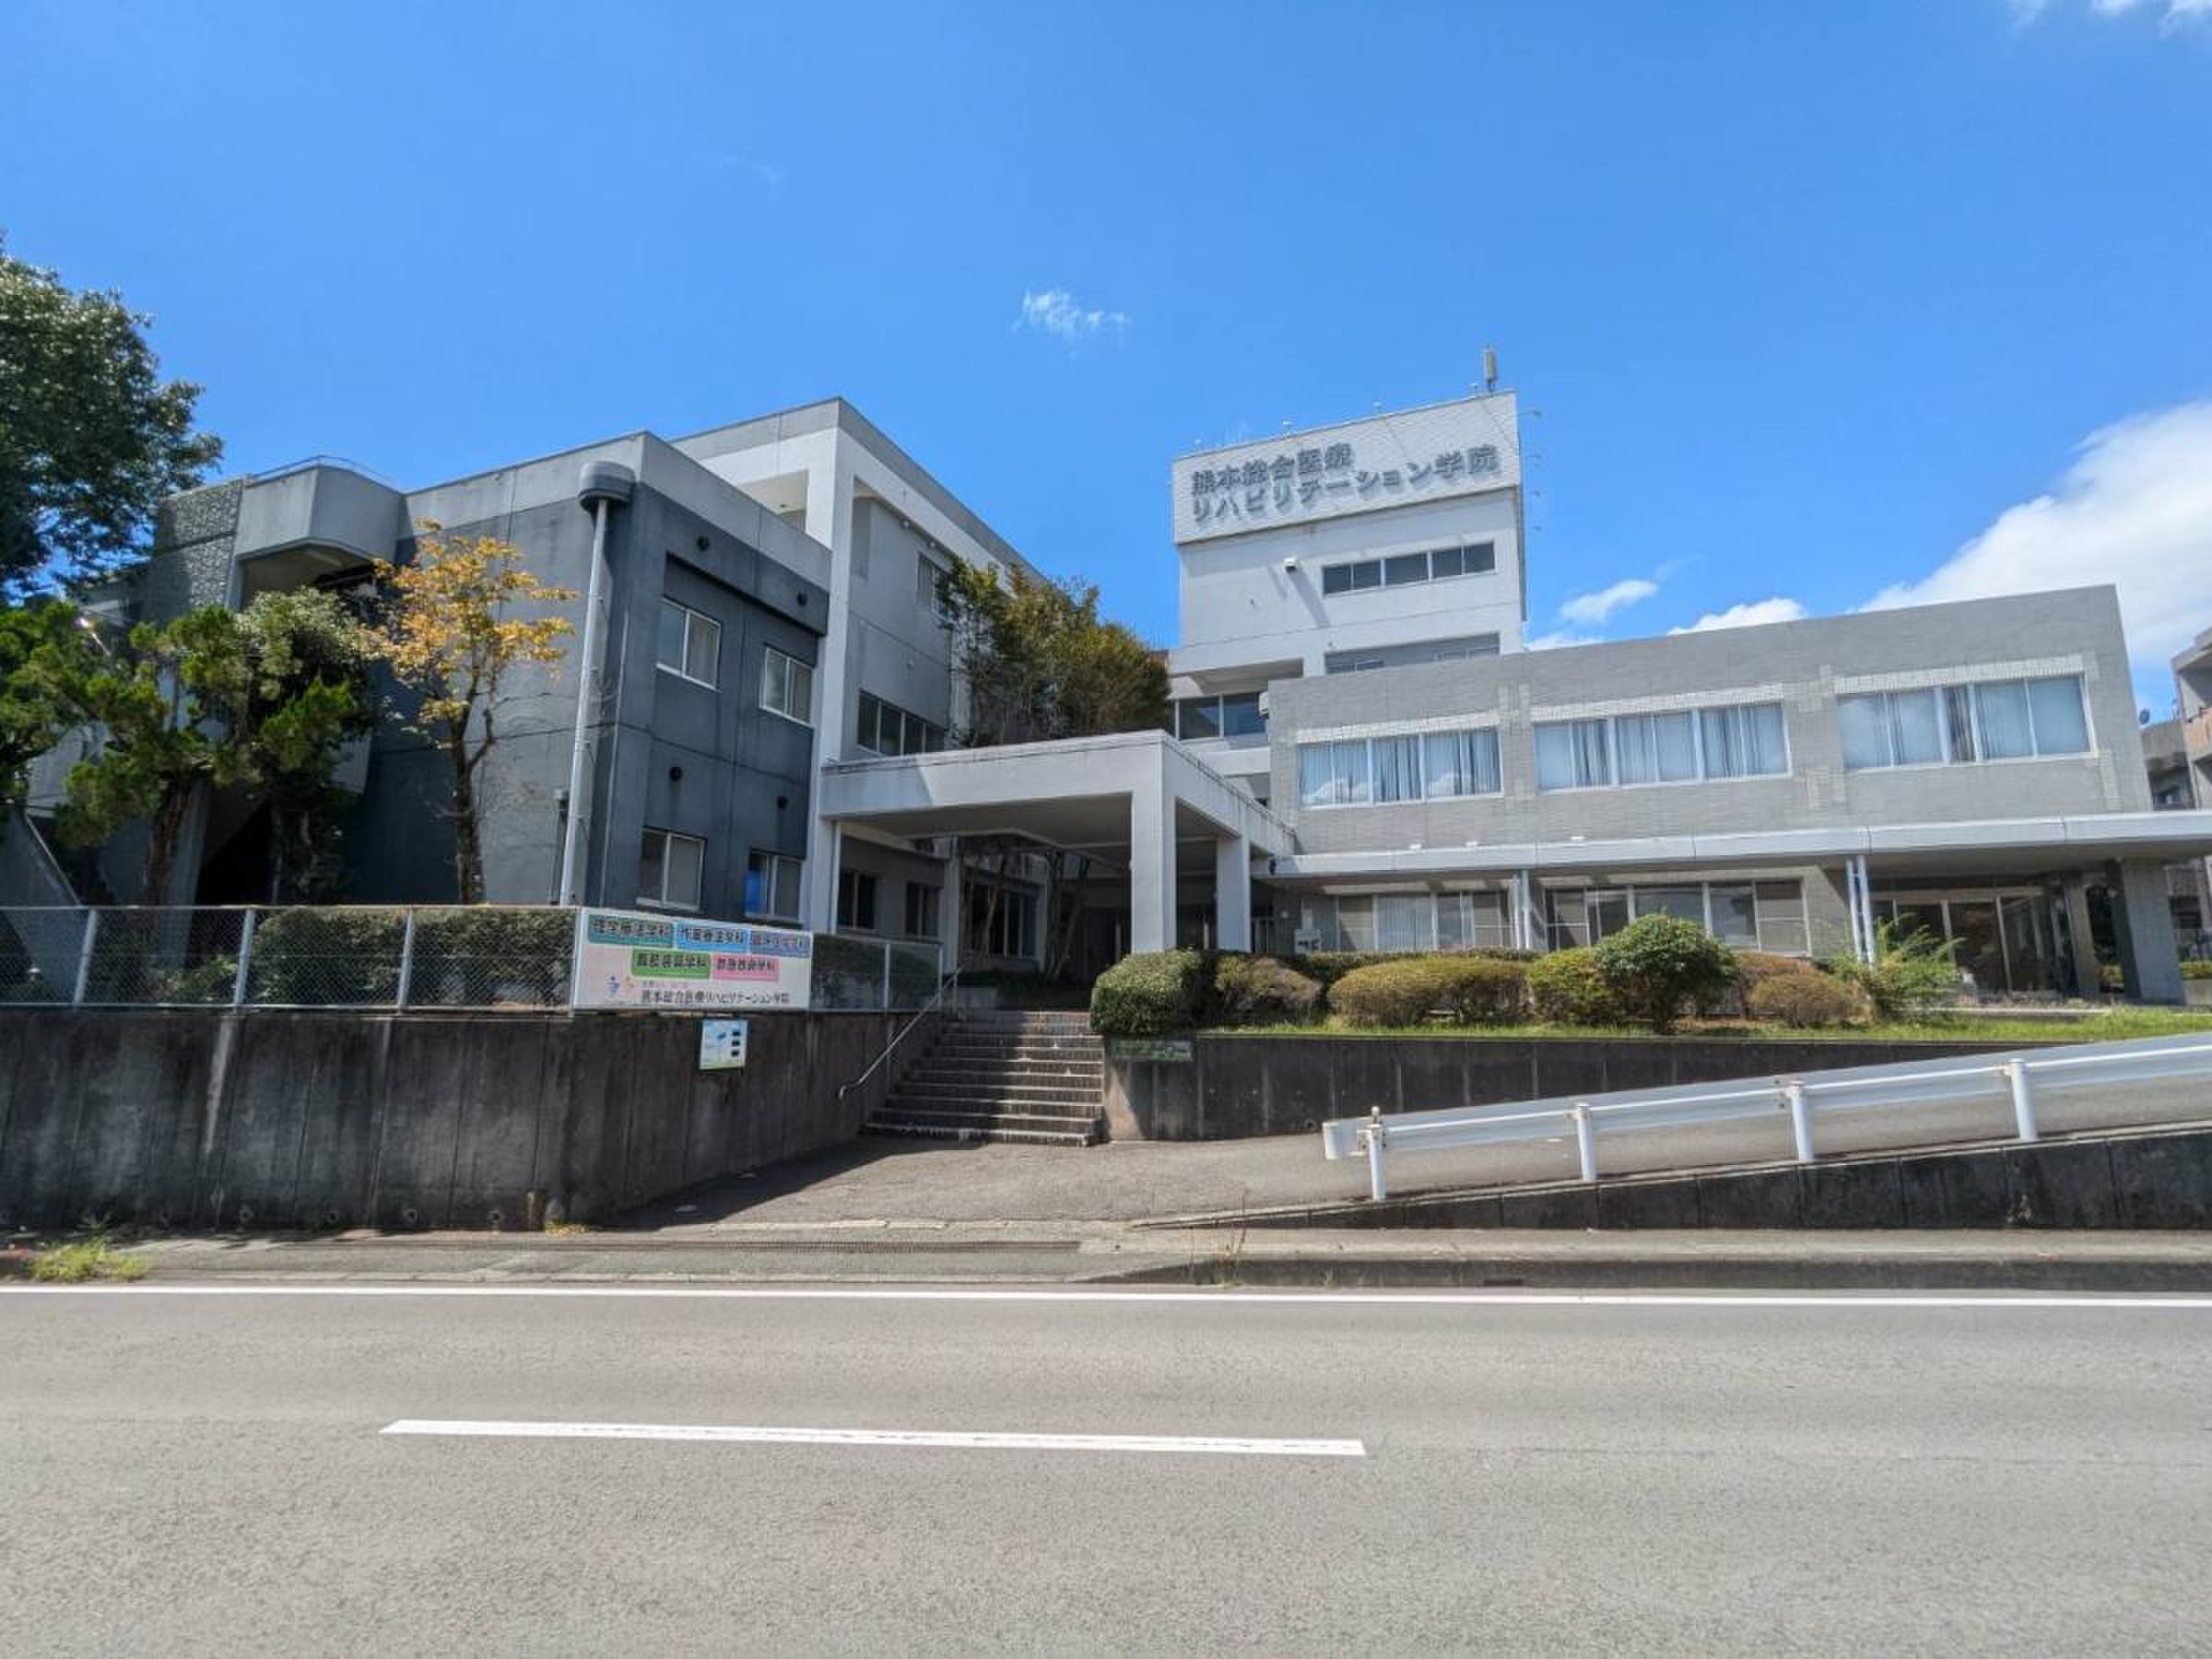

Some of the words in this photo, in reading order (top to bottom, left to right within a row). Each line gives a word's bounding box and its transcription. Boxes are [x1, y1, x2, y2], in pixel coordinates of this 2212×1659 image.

[1192, 442, 1351, 496] 熊本総合医療
[1193, 444, 1499, 524] リハビリテーション学院
